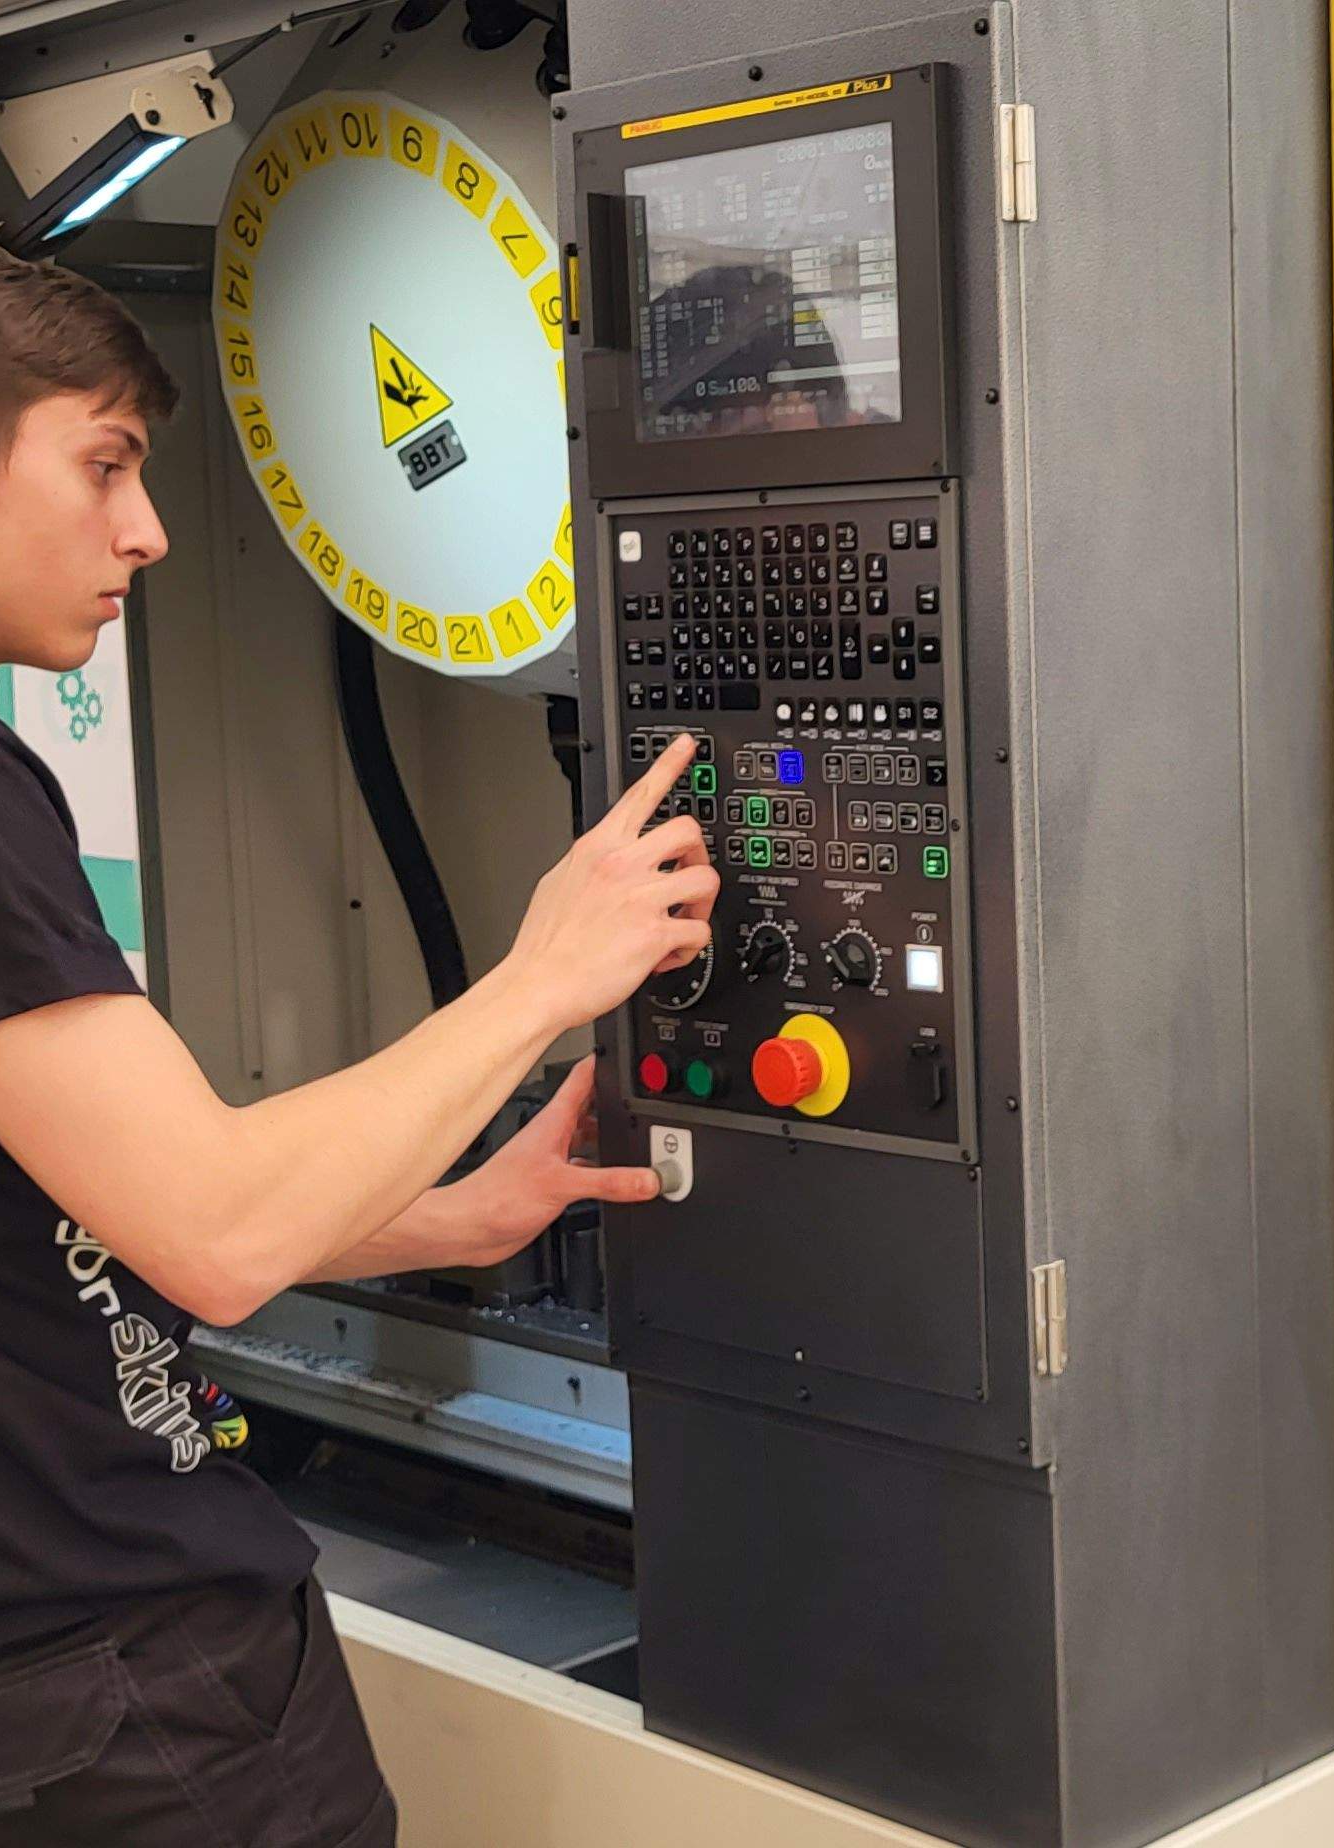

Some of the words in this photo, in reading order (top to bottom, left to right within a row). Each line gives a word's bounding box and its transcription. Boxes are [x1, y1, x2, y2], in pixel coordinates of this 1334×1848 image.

[854, 79, 878, 93] Plus
[295, 120, 327, 162] 11
[341, 112, 378, 149] 10
[402, 125, 423, 162] 9
[255, 150, 289, 196] 12
[455, 162, 480, 200] 8
[234, 201, 262, 248] 13
[501, 234, 528, 260] 7
[226, 263, 249, 309] 14
[228, 331, 254, 379] 15
[243, 401, 273, 450] 16
[409, 434, 451, 477] BBT
[270, 469, 304, 510] 17
[308, 530, 340, 577] 18
[352, 578, 384, 620] 19
[539, 575, 566, 612] 2
[401, 609, 438, 648] 20
[450, 622, 484, 656] 21
[505, 611, 523, 643] 1
